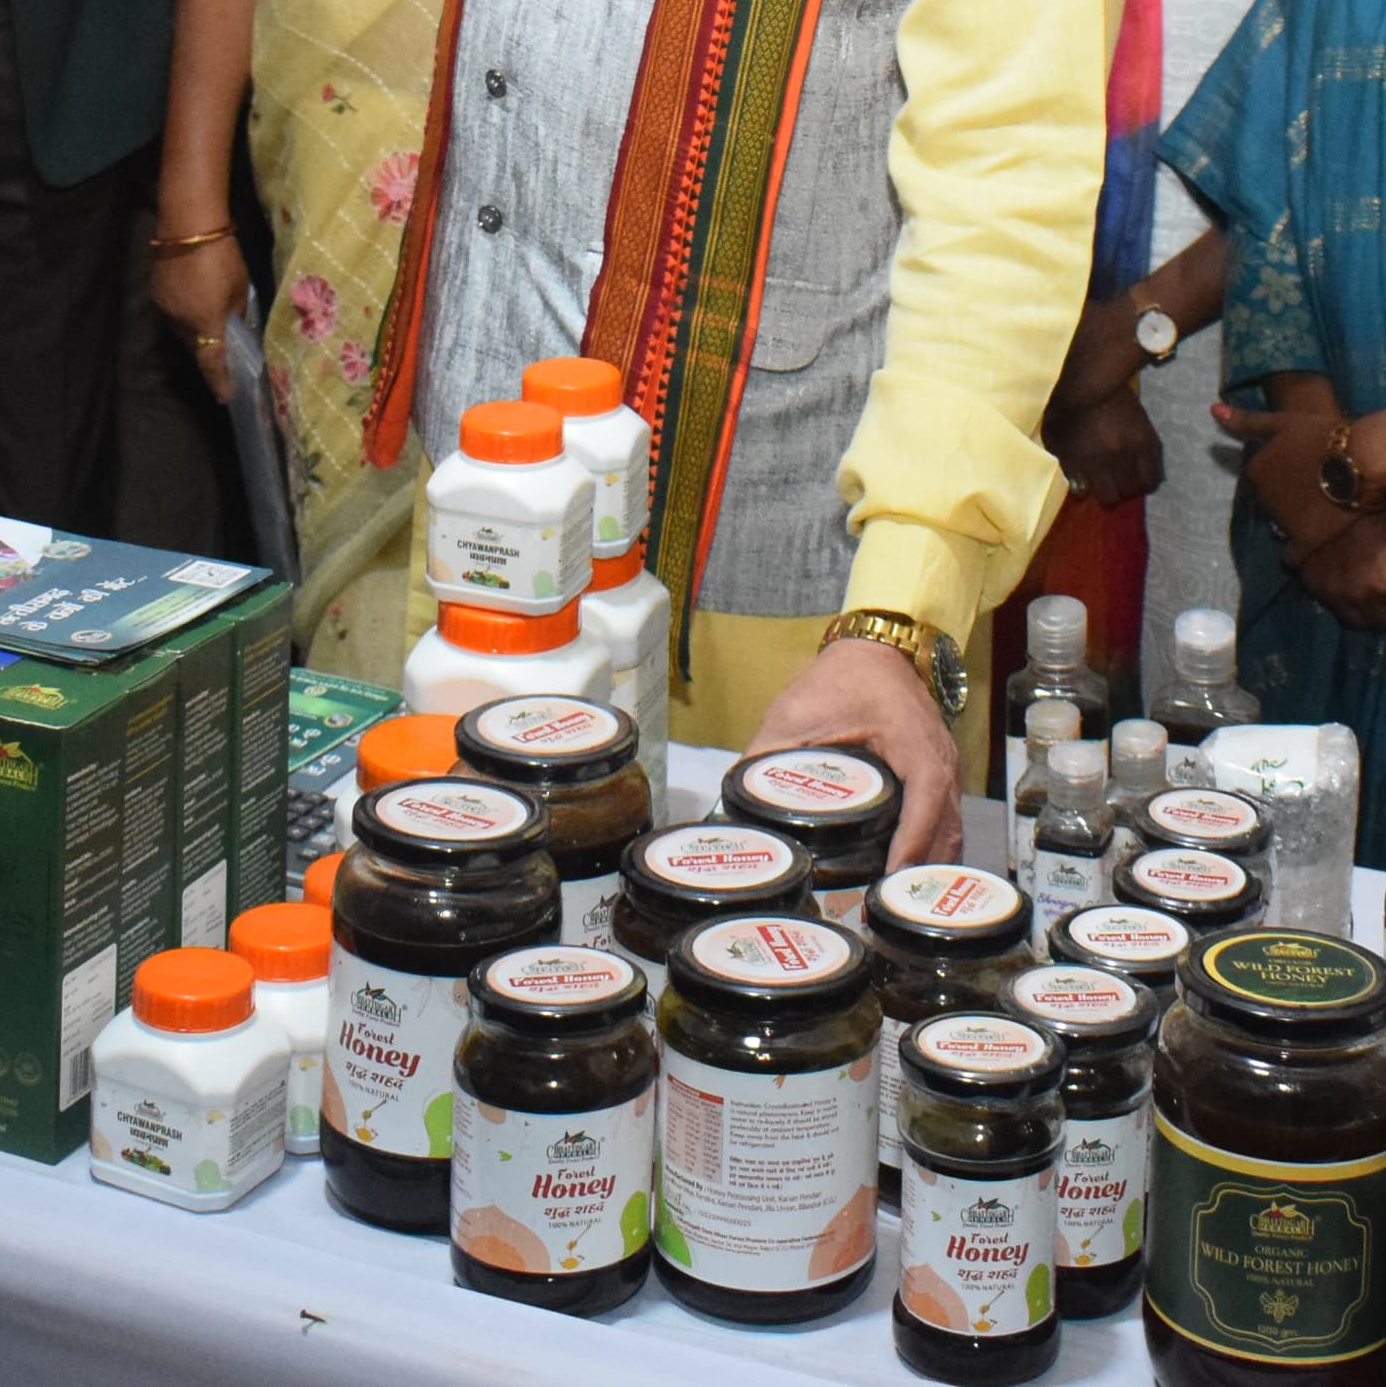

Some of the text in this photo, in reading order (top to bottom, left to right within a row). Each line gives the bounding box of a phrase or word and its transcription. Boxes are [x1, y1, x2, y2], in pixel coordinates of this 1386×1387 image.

[457, 540, 520, 559] CHYAWANPRASH
[723, 852, 770, 864] Honey
[1232, 960, 1355, 977] WILD FOREST
[513, 973, 610, 987] Forest Honey
[1261, 971, 1328, 984] HONEY
[1078, 993, 1117, 1002] Honey
[358, 1022, 394, 1046] Forest
[339, 1019, 421, 1078] Honey
[983, 1043, 1025, 1053] Honey
[364, 1086, 401, 1103] NATURAL
[117, 1110, 182, 1142] CHYAWANPRASH
[557, 1165, 595, 1180] Forest
[1074, 1170, 1110, 1183] Forest
[532, 1173, 616, 1199] Honey
[971, 1232, 1009, 1245] Forest
[946, 1234, 1029, 1266] Honey
[1201, 1241, 1360, 1275] WILD FOREST HONEY
[1254, 1245, 1308, 1258] ORGANIC
